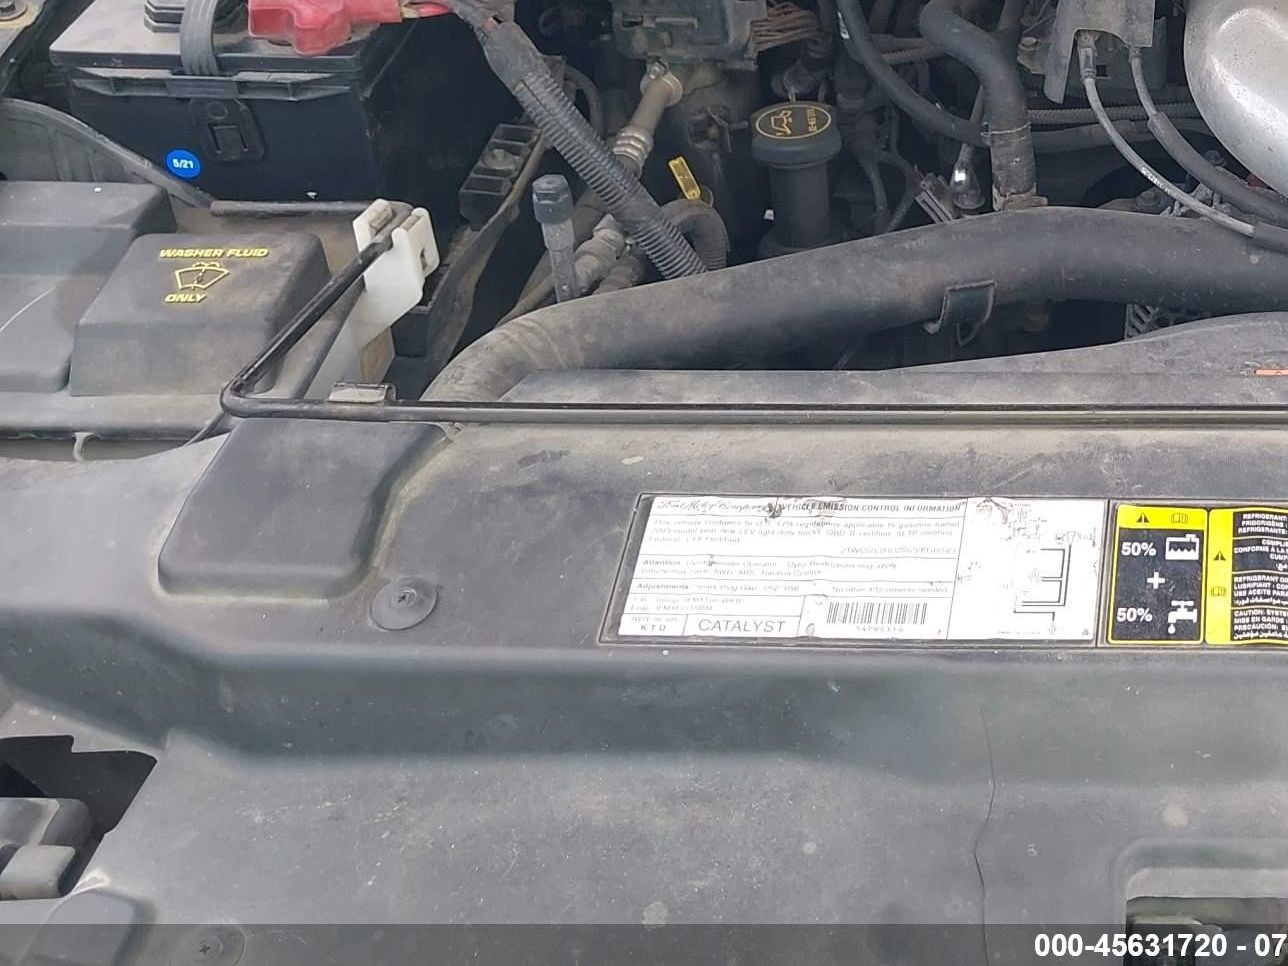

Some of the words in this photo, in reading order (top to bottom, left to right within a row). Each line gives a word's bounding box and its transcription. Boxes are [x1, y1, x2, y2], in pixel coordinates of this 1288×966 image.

[172, 158, 194, 169] 5/21
[160, 249, 222, 258] WASHER
[226, 249, 269, 258] FLUID
[165, 293, 207, 303] ONLY
[817, 501, 858, 511] EMISSION
[861, 503, 899, 512] CONTROL
[903, 503, 961, 512] INFORMATION
[1121, 541, 1157, 556] 50%
[1116, 607, 1153, 622] 50%
[698, 618, 787, 633] CATALYST
